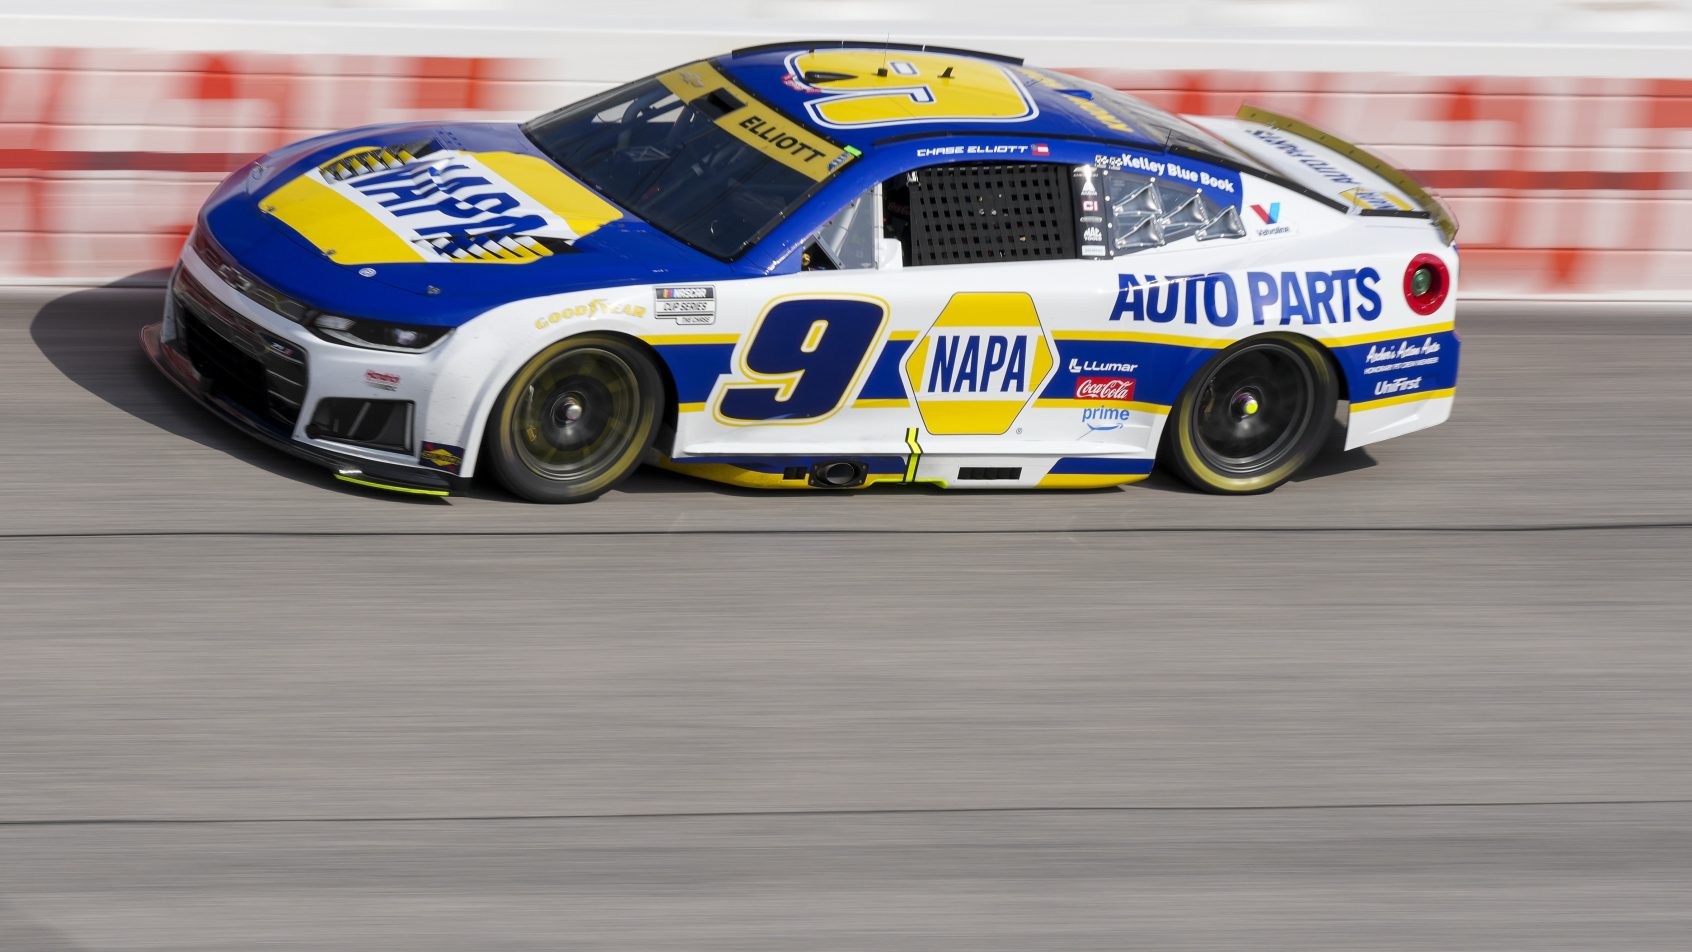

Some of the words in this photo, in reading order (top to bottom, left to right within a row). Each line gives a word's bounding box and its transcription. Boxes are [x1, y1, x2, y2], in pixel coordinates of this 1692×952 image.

[739, 116, 825, 162] ELLIOTT
[917, 145, 964, 157] CHASE
[967, 145, 1028, 154] ELLIOTT
[1122, 153, 1166, 176] Kelley
[1167, 163, 1199, 183] Blue
[1200, 171, 1235, 193] Book
[534, 299, 647, 330] GOODYEAR
[680, 301, 708, 311] SERIES
[1108, 271, 1239, 327] AUTO
[1247, 266, 1382, 326] PARTS
[714, 292, 890, 427] 9
[928, 335, 1025, 393] NAPA
[1082, 404, 1130, 423] prime
